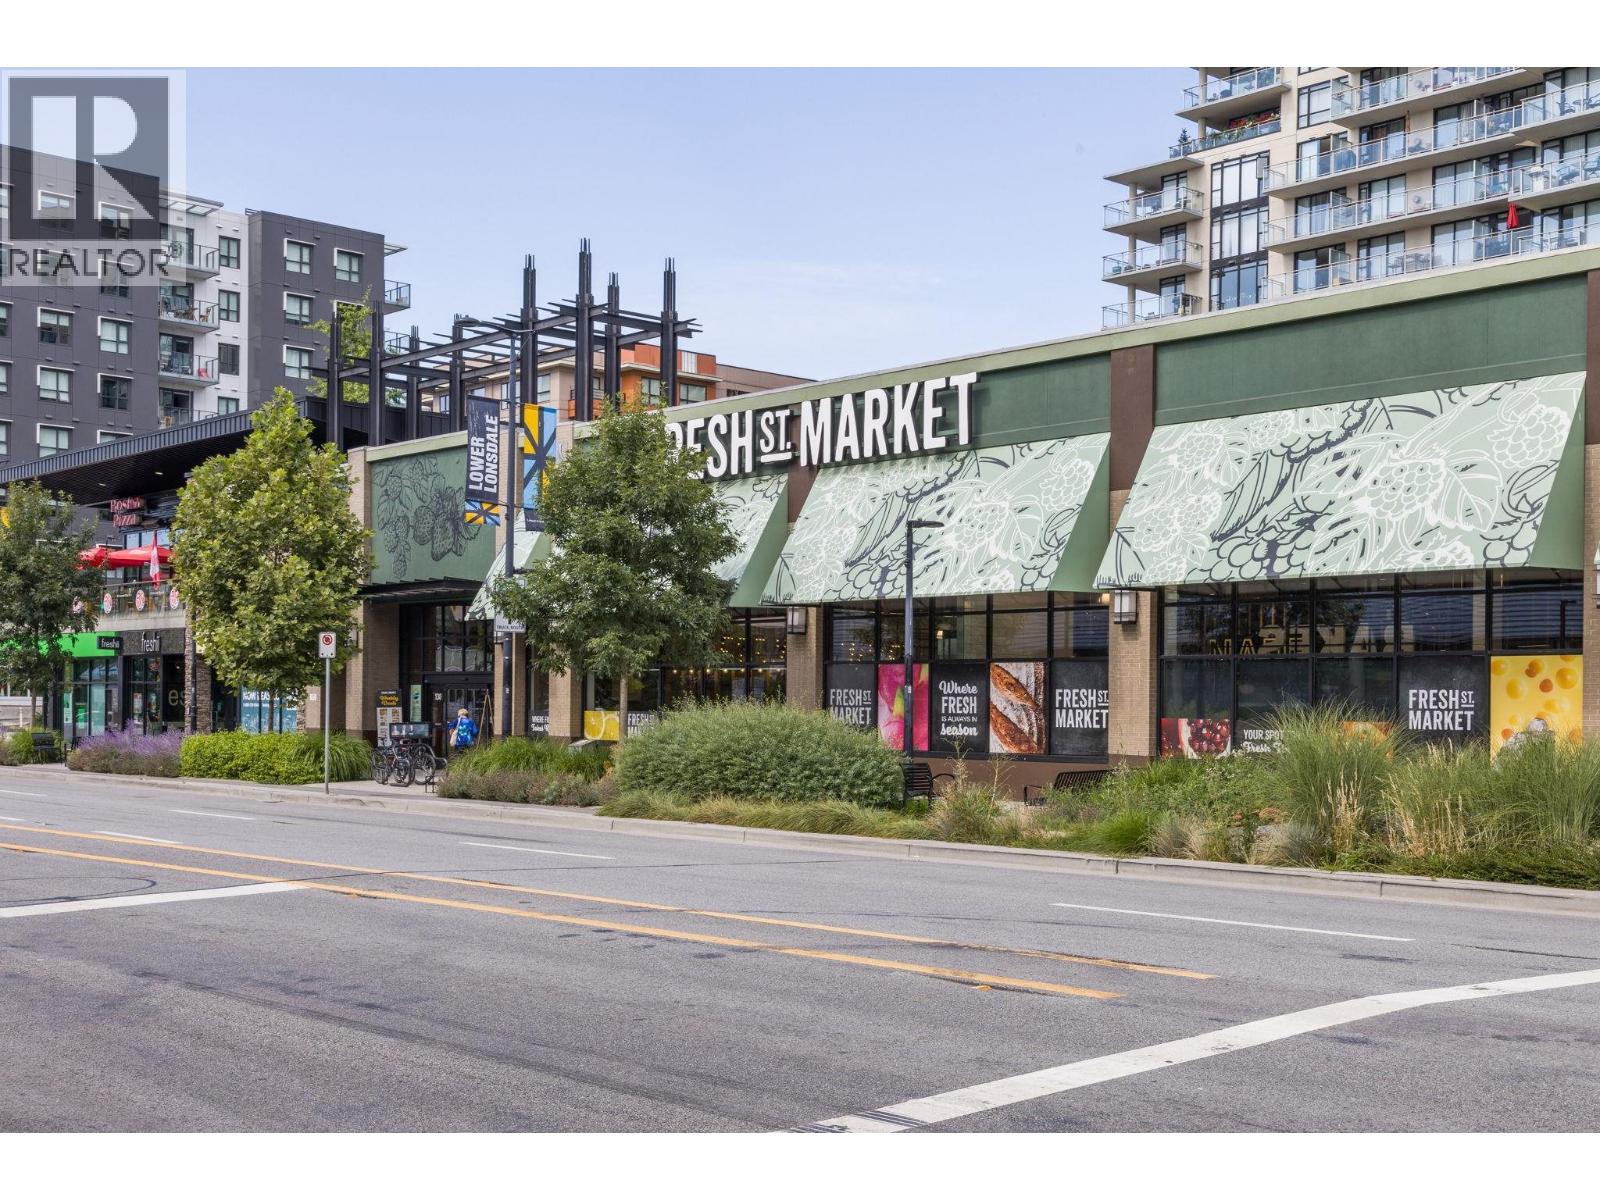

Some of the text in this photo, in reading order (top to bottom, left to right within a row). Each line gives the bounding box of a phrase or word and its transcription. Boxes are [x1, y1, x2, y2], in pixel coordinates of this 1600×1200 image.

[662, 409, 753, 479] RESH
[799, 371, 978, 467] MARKET
[468, 435, 485, 491] LOWER
[483, 414, 498, 494] LONSDALE
[829, 688, 862, 706] FRESH
[938, 680, 979, 695] Where
[941, 696, 977, 714] FRESH
[1055, 688, 1097, 708] FRESH
[1408, 689, 1475, 710] FRESH ST.
[829, 706, 872, 725] MARKET
[1055, 708, 1109, 729] MARKET
[1408, 710, 1475, 731] MARKET
[939, 723, 979, 736] season
[1243, 729, 1264, 740] YOUR
